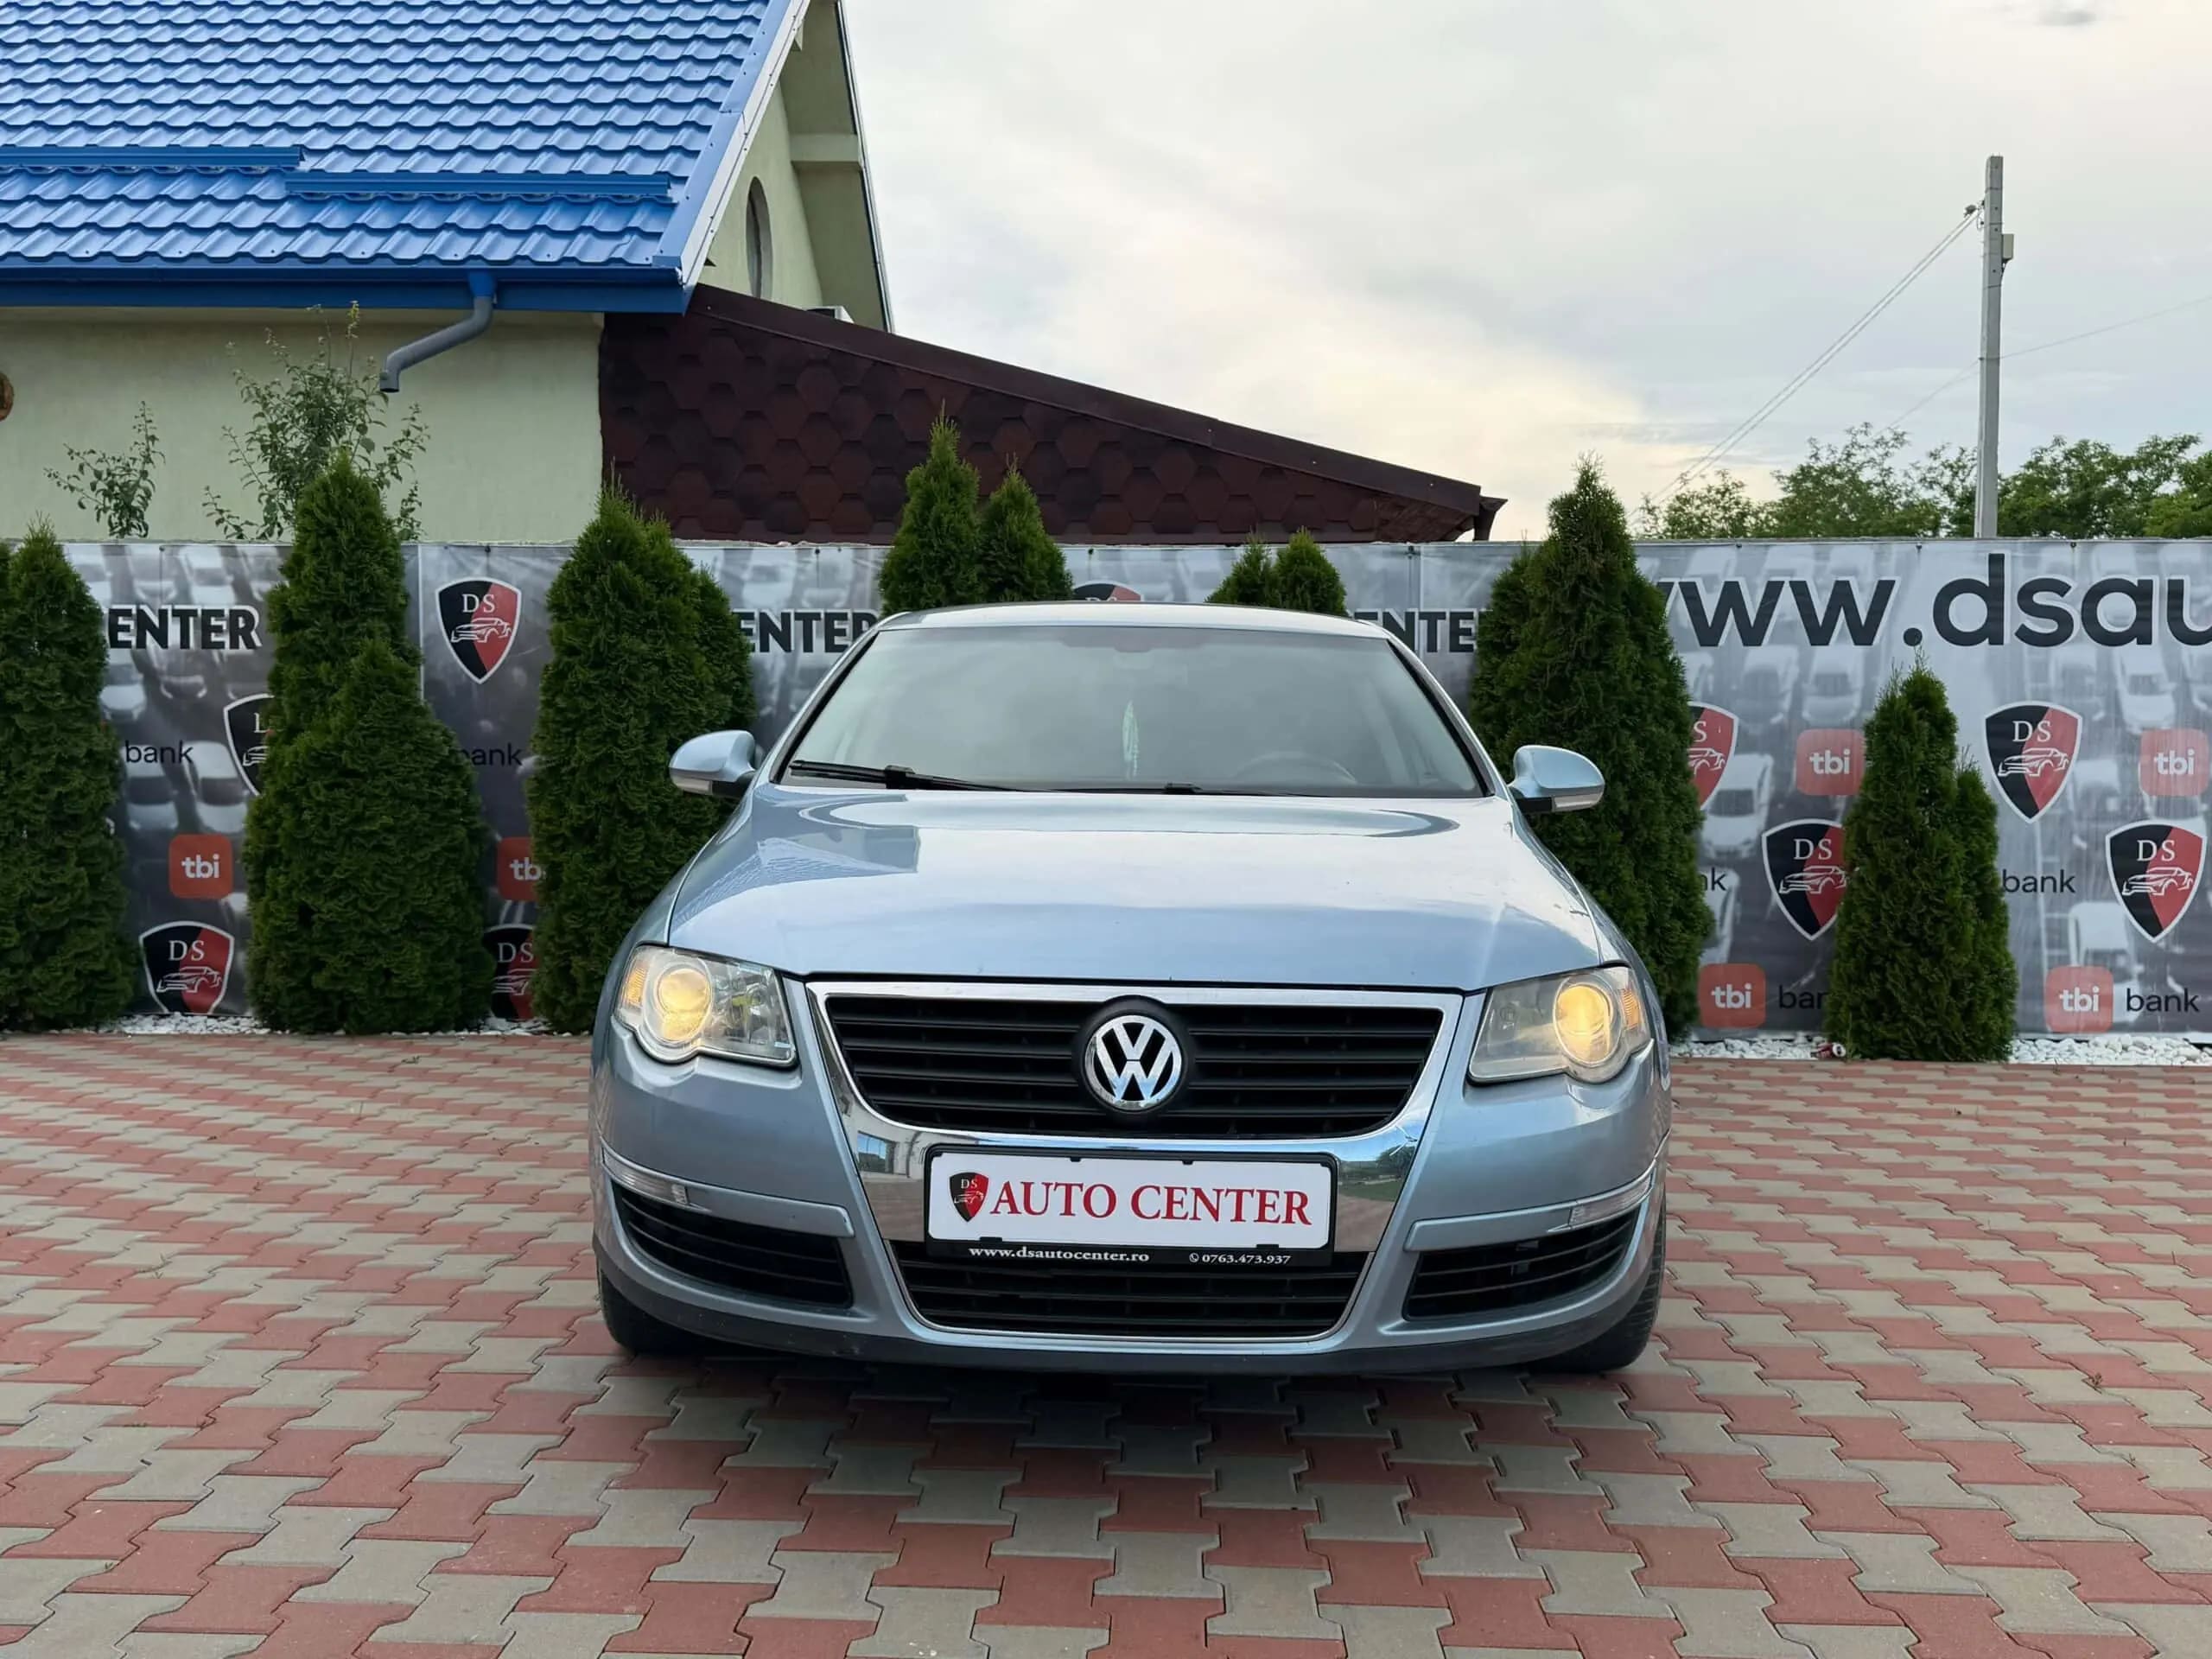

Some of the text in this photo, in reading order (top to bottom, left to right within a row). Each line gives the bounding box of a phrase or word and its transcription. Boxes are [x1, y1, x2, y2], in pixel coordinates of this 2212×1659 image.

[462, 594, 496, 613] DS
[1656, 553, 2212, 647] ww.dsau
[108, 608, 261, 650] ENTER
[1354, 612, 1482, 652] NTE
[2012, 721, 2051, 742] DS
[125, 741, 194, 764] bank
[1809, 749, 1851, 774] tbi
[2154, 749, 2195, 775] tbi
[1794, 839, 1832, 860] DS
[2136, 840, 2176, 861] DS
[181, 854, 219, 879] tbi
[510, 857, 546, 880] tb
[2002, 869, 2075, 893] bank
[168, 940, 205, 961] DS
[498, 943, 534, 963] DS
[1711, 983, 1752, 1008] tbi
[2059, 986, 2200, 1012] tbi bank
[961, 1179, 1313, 1225] DS AUTO CENTER
[969, 1246, 1291, 1264] www.dsautocenter.ro 0763.473.937
